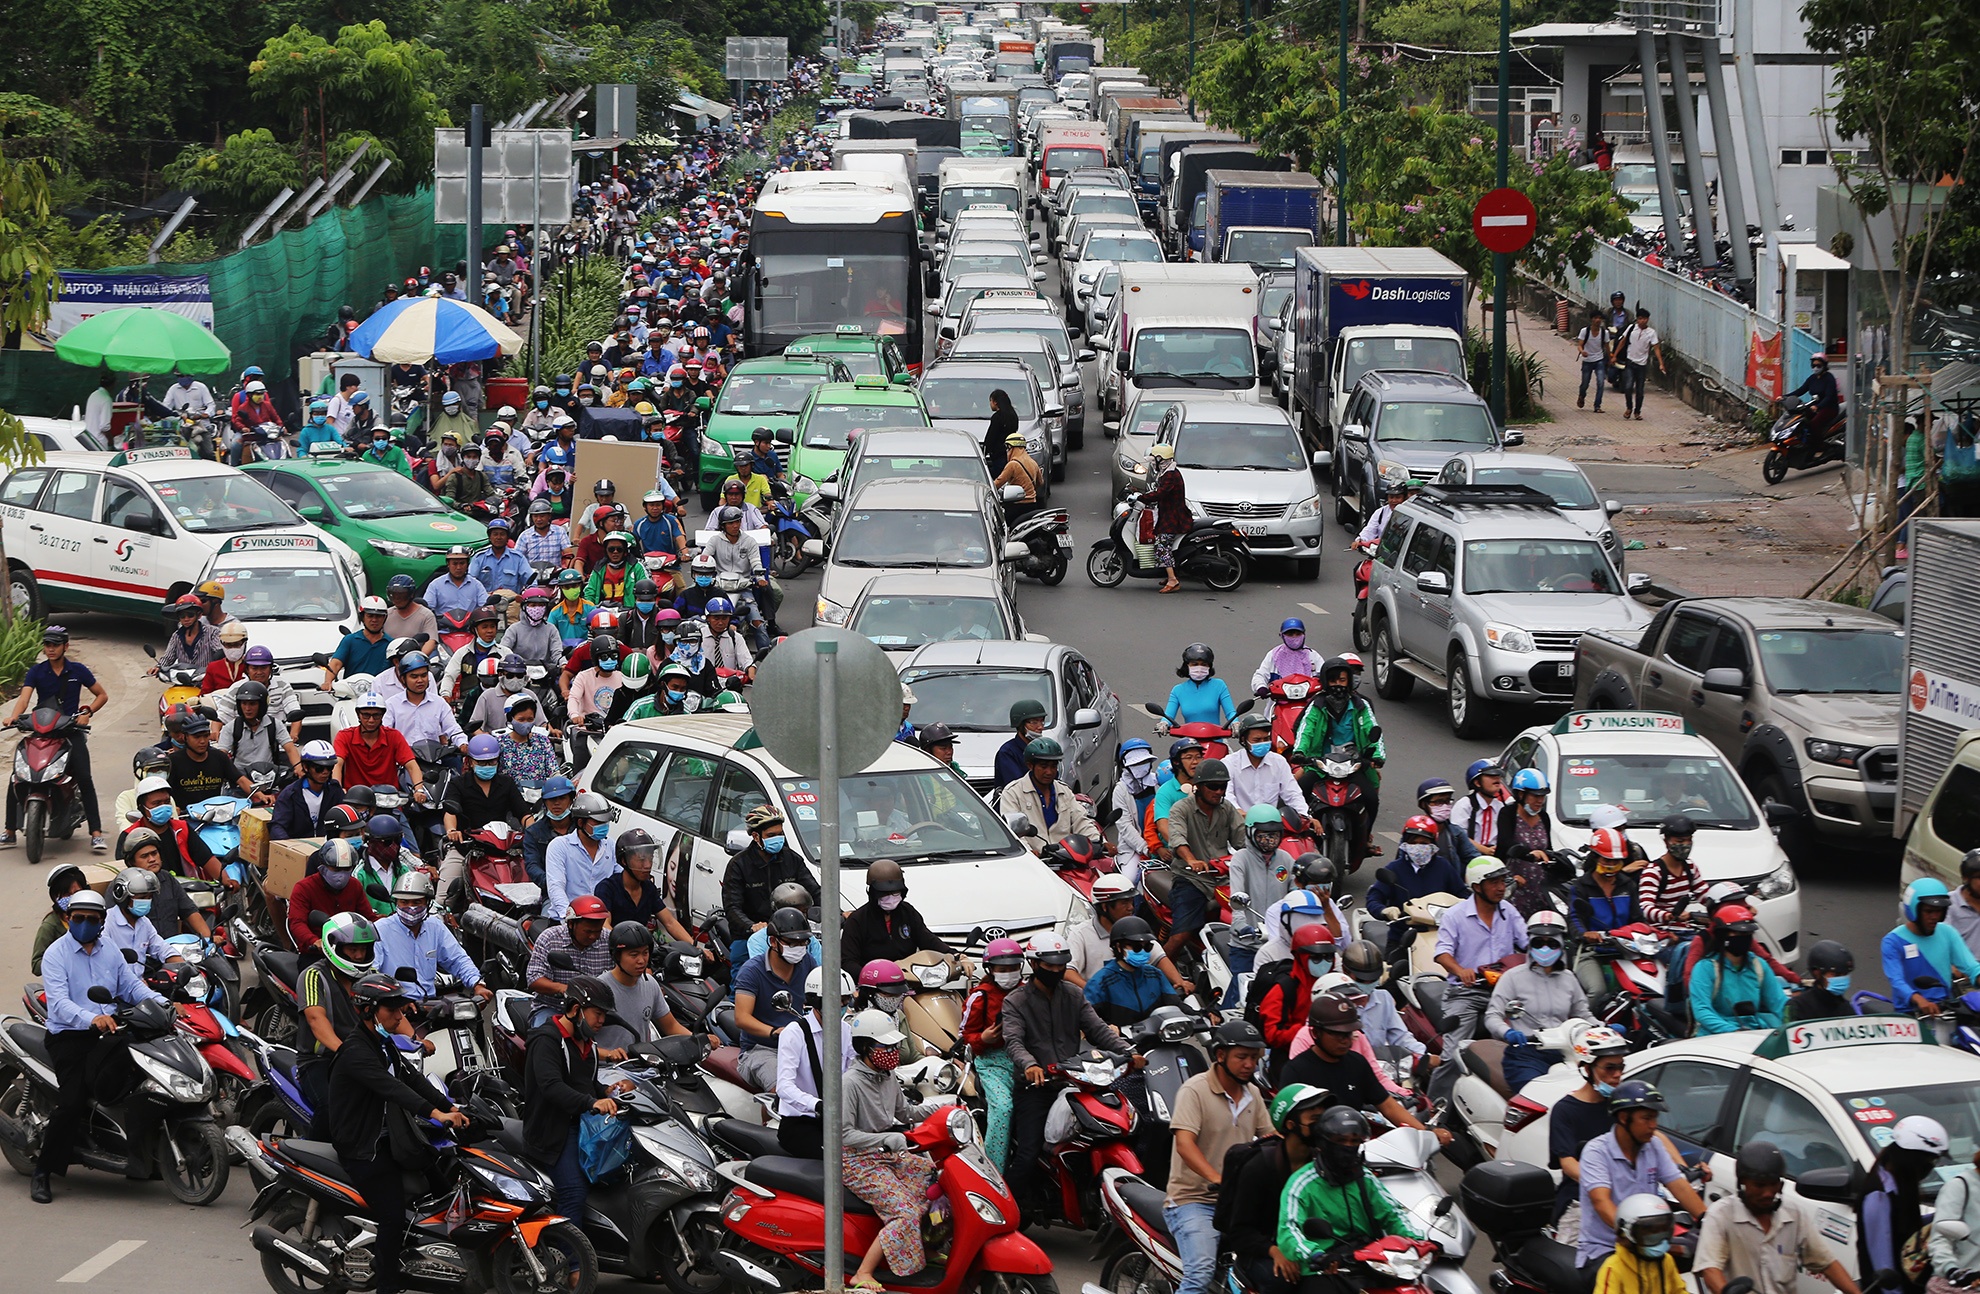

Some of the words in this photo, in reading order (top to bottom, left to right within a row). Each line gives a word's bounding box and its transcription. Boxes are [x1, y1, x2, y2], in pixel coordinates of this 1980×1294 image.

[1372, 286, 1405, 302] Dash
[1406, 288, 1450, 302] Logistics
[1598, 716, 1654, 729] VINASUN
[1655, 716, 1682, 730] TAXI
[789, 794, 815, 803] 4518
[1820, 1024, 1886, 1042] VINASUN
[1887, 1022, 1917, 1039] TAXI
